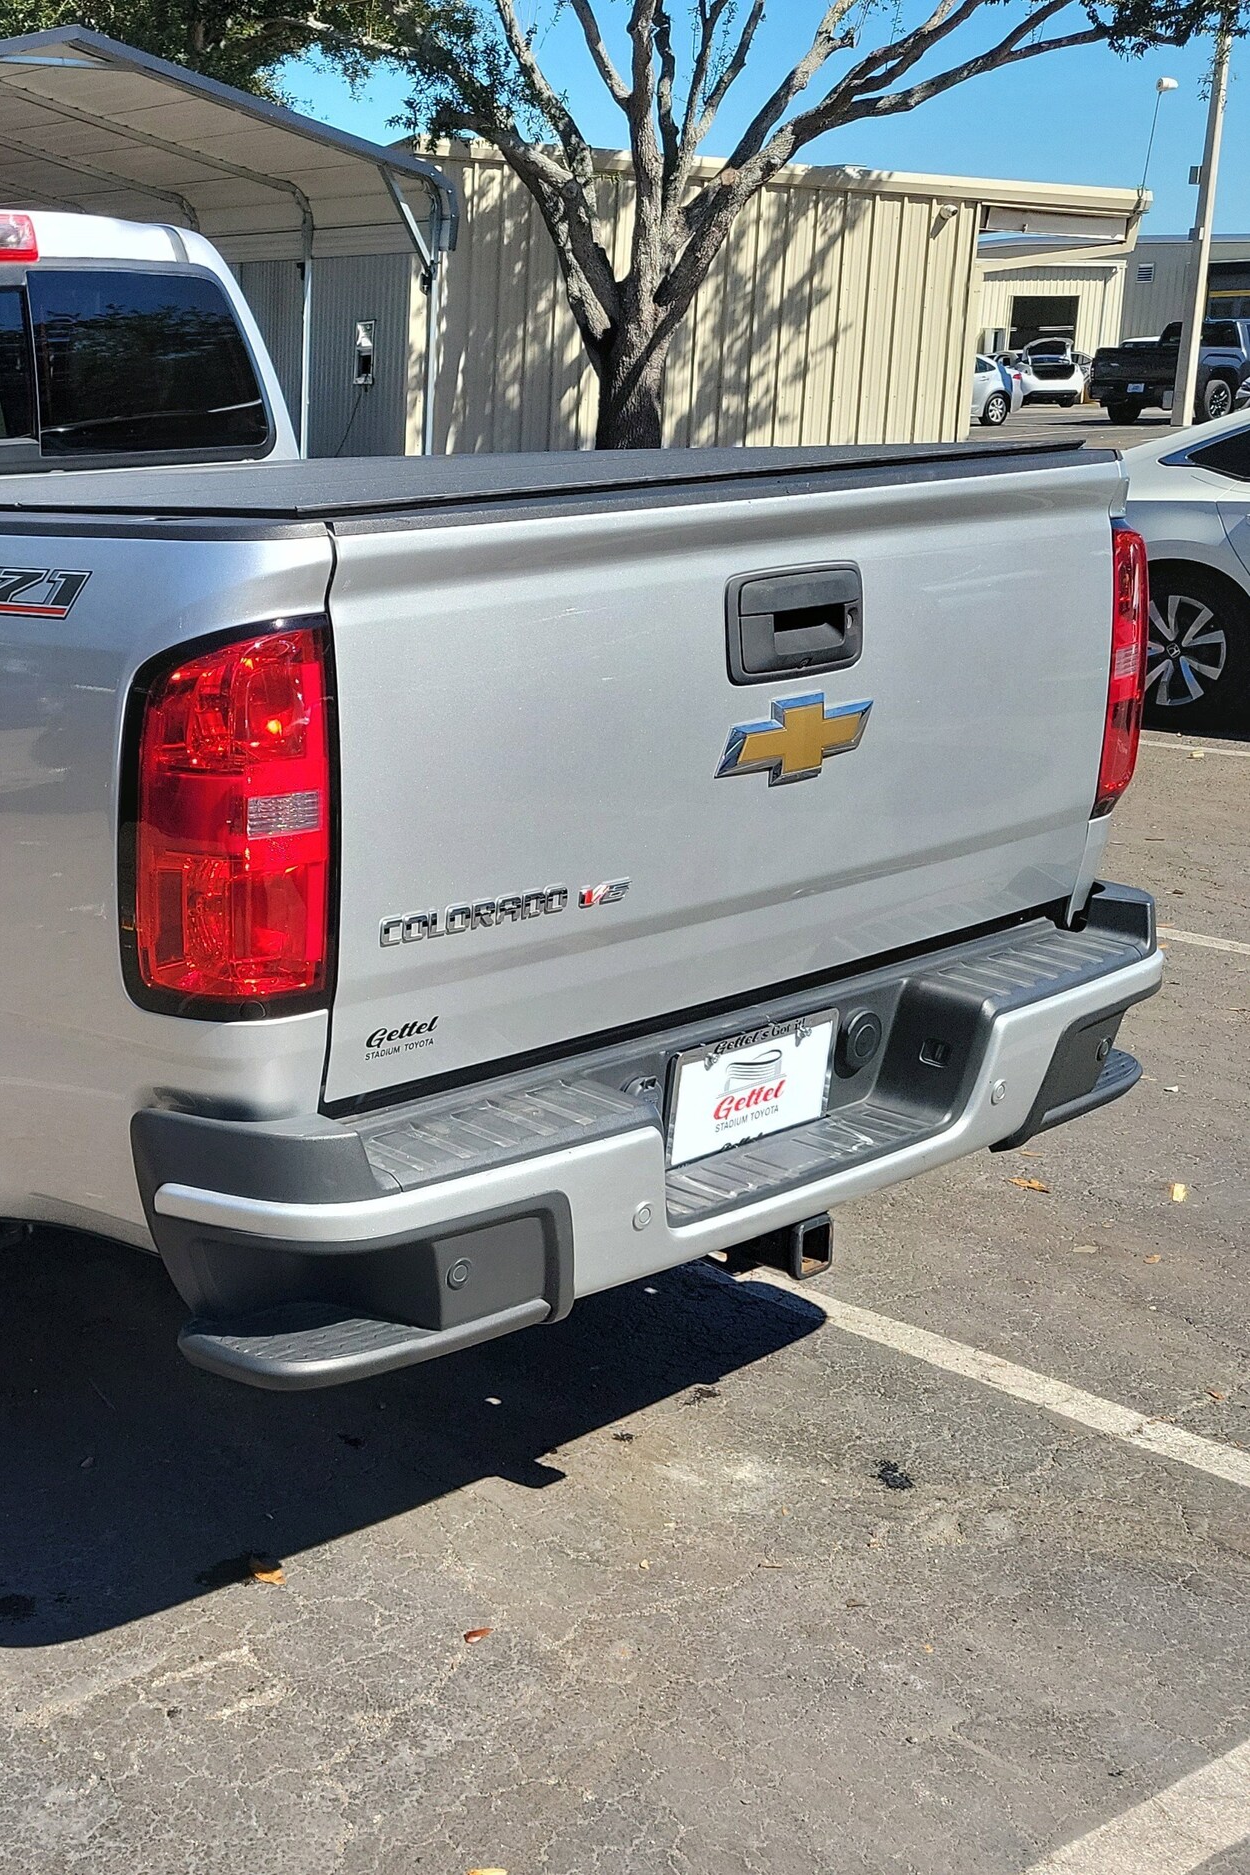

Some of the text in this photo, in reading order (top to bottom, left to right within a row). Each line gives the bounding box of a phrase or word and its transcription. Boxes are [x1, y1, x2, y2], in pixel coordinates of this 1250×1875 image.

[379, 876, 632, 947] COLORADO V6
[365, 1015, 439, 1049] Gettel
[713, 1030, 770, 1055] Gettel's
[365, 1037, 434, 1061] STADIUM TOYOTA
[712, 1079, 786, 1121] Gettel
[714, 1104, 779, 1133] STADIUM TOYOTA
